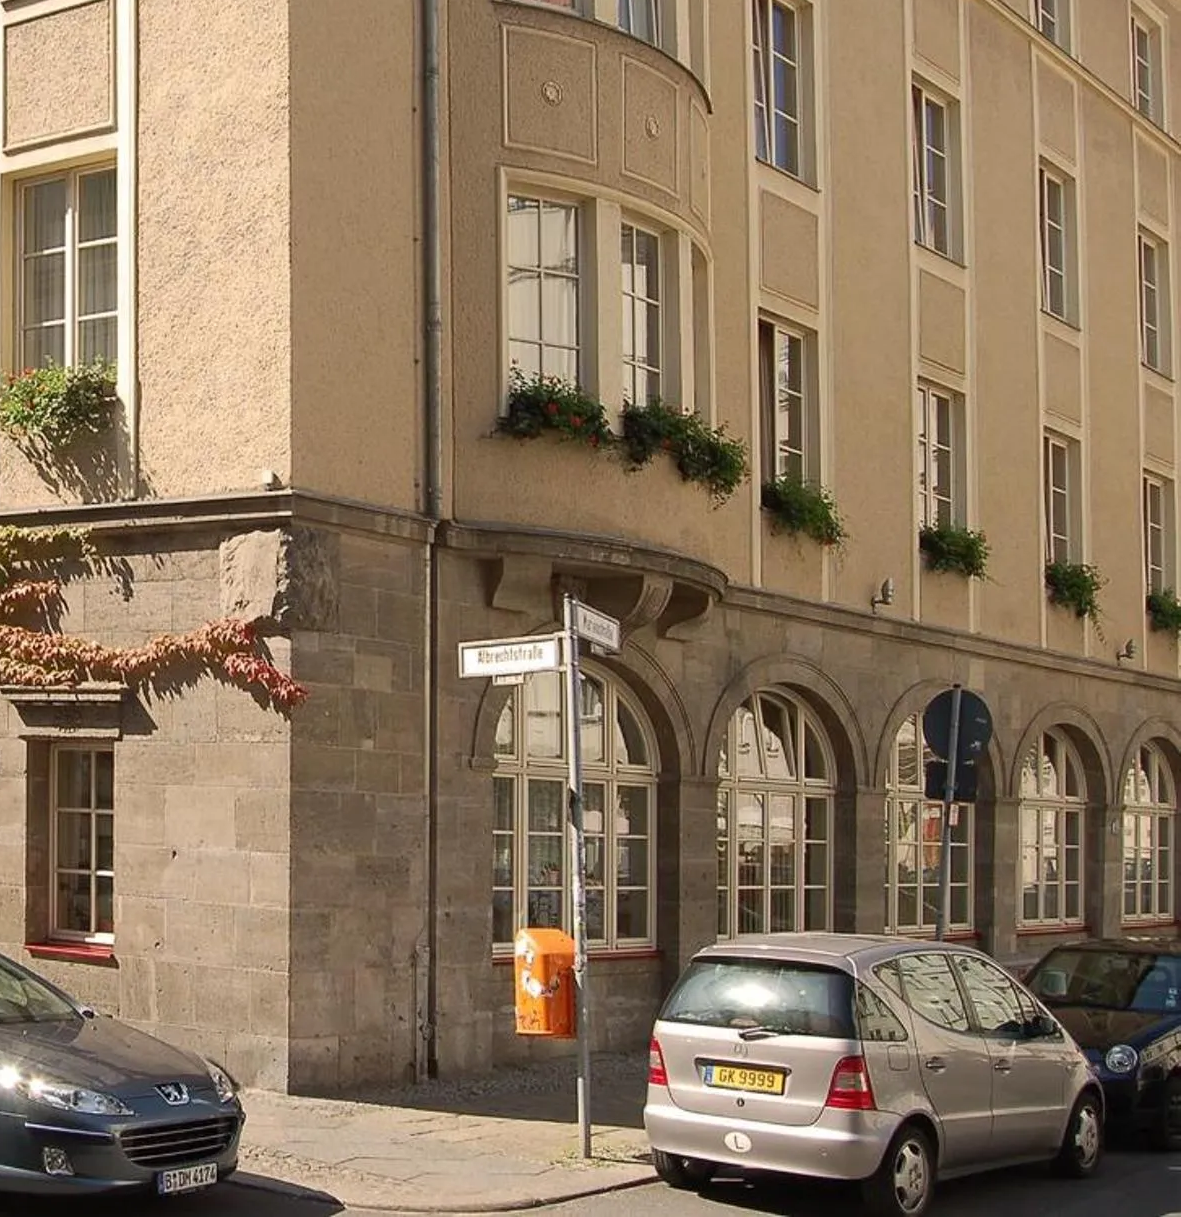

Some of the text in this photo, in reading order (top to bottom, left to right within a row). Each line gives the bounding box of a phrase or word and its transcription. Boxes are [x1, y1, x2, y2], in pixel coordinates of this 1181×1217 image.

[718, 1068, 775, 1089] GK 9999
[733, 1133, 745, 1150] L
